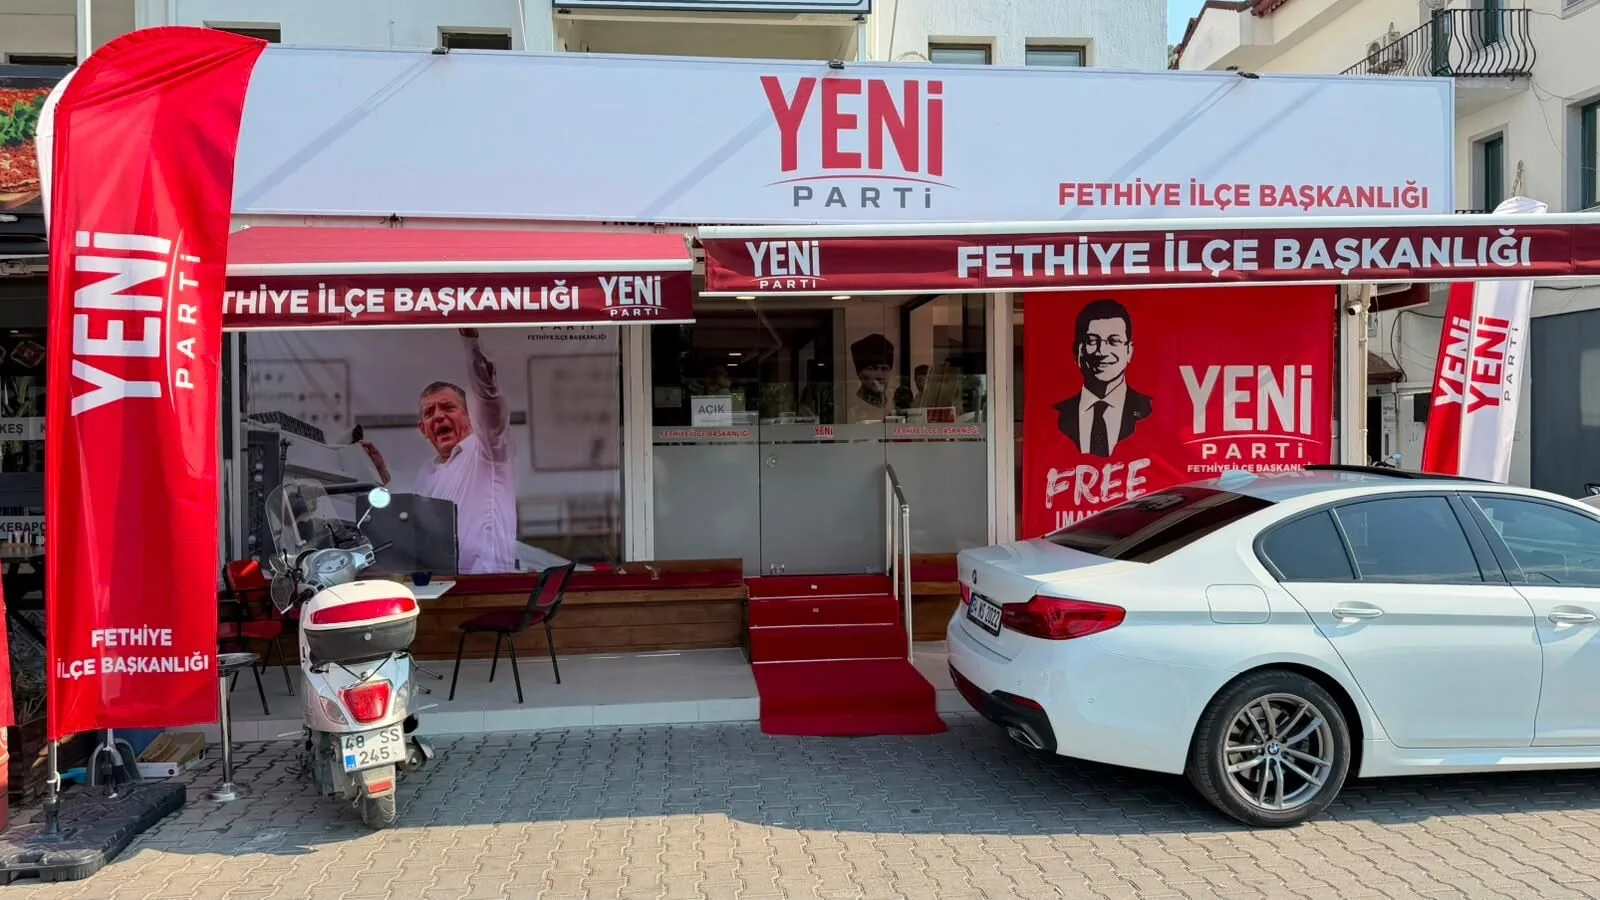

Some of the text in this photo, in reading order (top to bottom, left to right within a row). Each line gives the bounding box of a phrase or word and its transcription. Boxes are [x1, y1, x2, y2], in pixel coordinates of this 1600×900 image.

[1059, 177, 1428, 212] FETHİYE İLÇE BAŞKANLIĞI
[957, 228, 1531, 278] FETHİYE İLÇE BAŞKANLIĞI
[318, 282, 384, 317] İLÇE
[394, 279, 579, 317] BAŞKANLIĞI
[698, 404, 726, 416] AÇIK
[1045, 458, 1151, 509] FREE
[91, 624, 172, 648] FETHİYE
[57, 651, 209, 680] İLÇE BAŞKANLIĞI
[345, 728, 400, 750] 48 SS
[359, 746, 390, 765] 245
